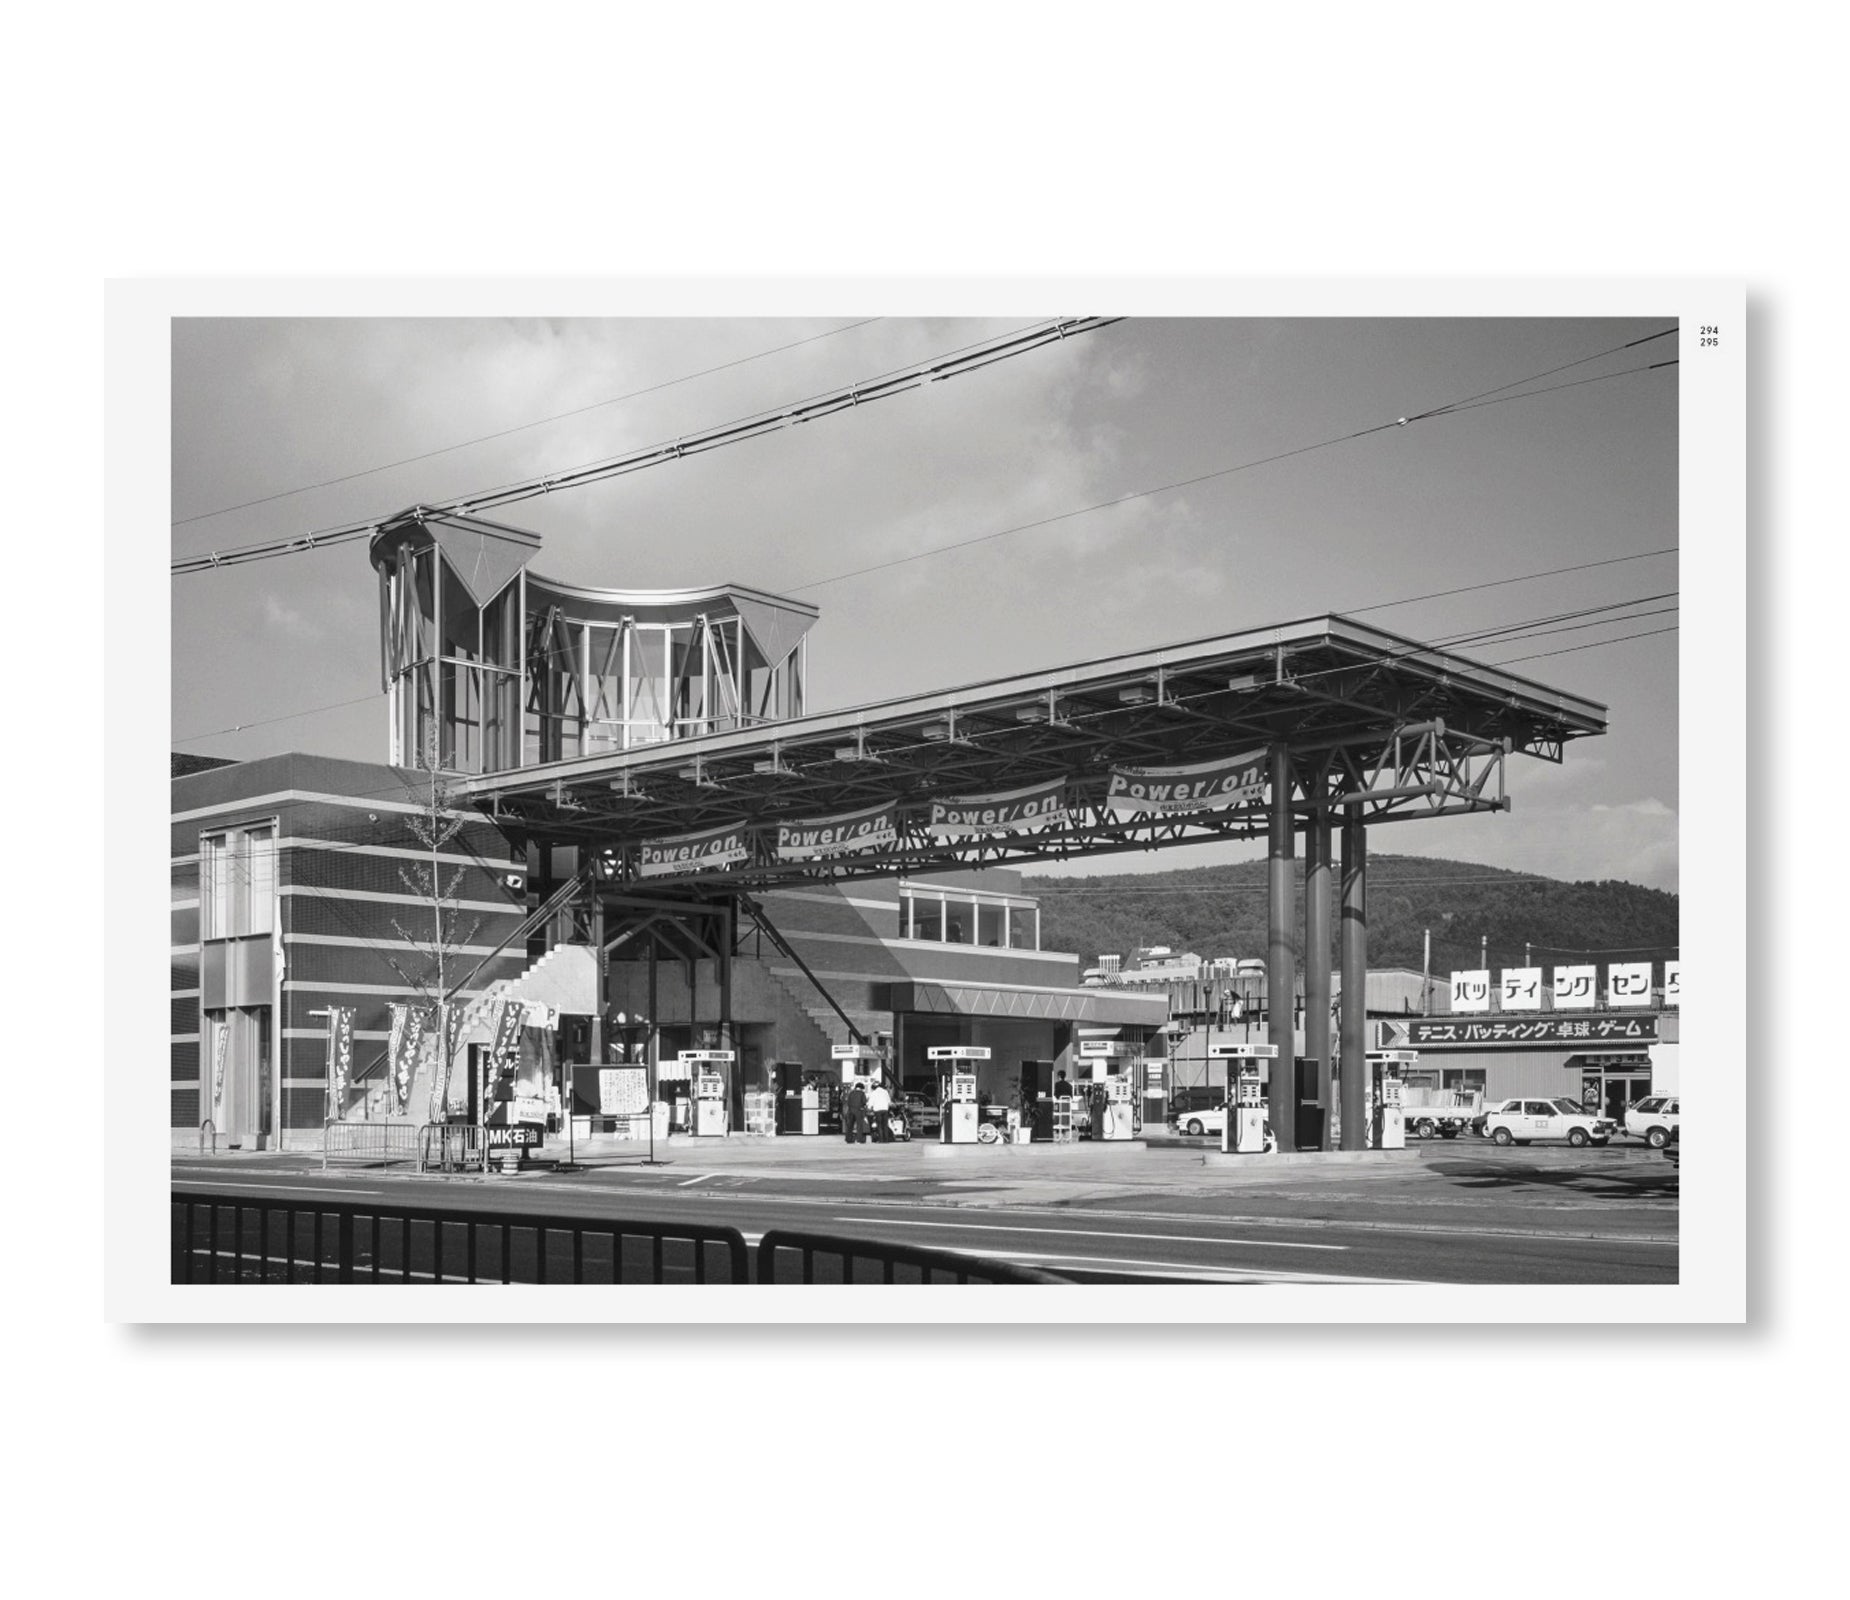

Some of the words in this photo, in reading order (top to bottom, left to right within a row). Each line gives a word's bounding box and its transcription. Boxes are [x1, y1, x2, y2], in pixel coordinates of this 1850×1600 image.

[1700, 325, 1718, 334] 294
[1700, 337, 1718, 346] 295
[1109, 767, 1263, 801] Power/on.
[931, 795, 1064, 825] Power/on.
[778, 815, 893, 847] Power/on.
[641, 834, 742, 865] Power/on.
[1418, 1019, 1658, 1040] テニス・バッティング・卓球・ゲーム・
[489, 1128, 538, 1145] MK石油
